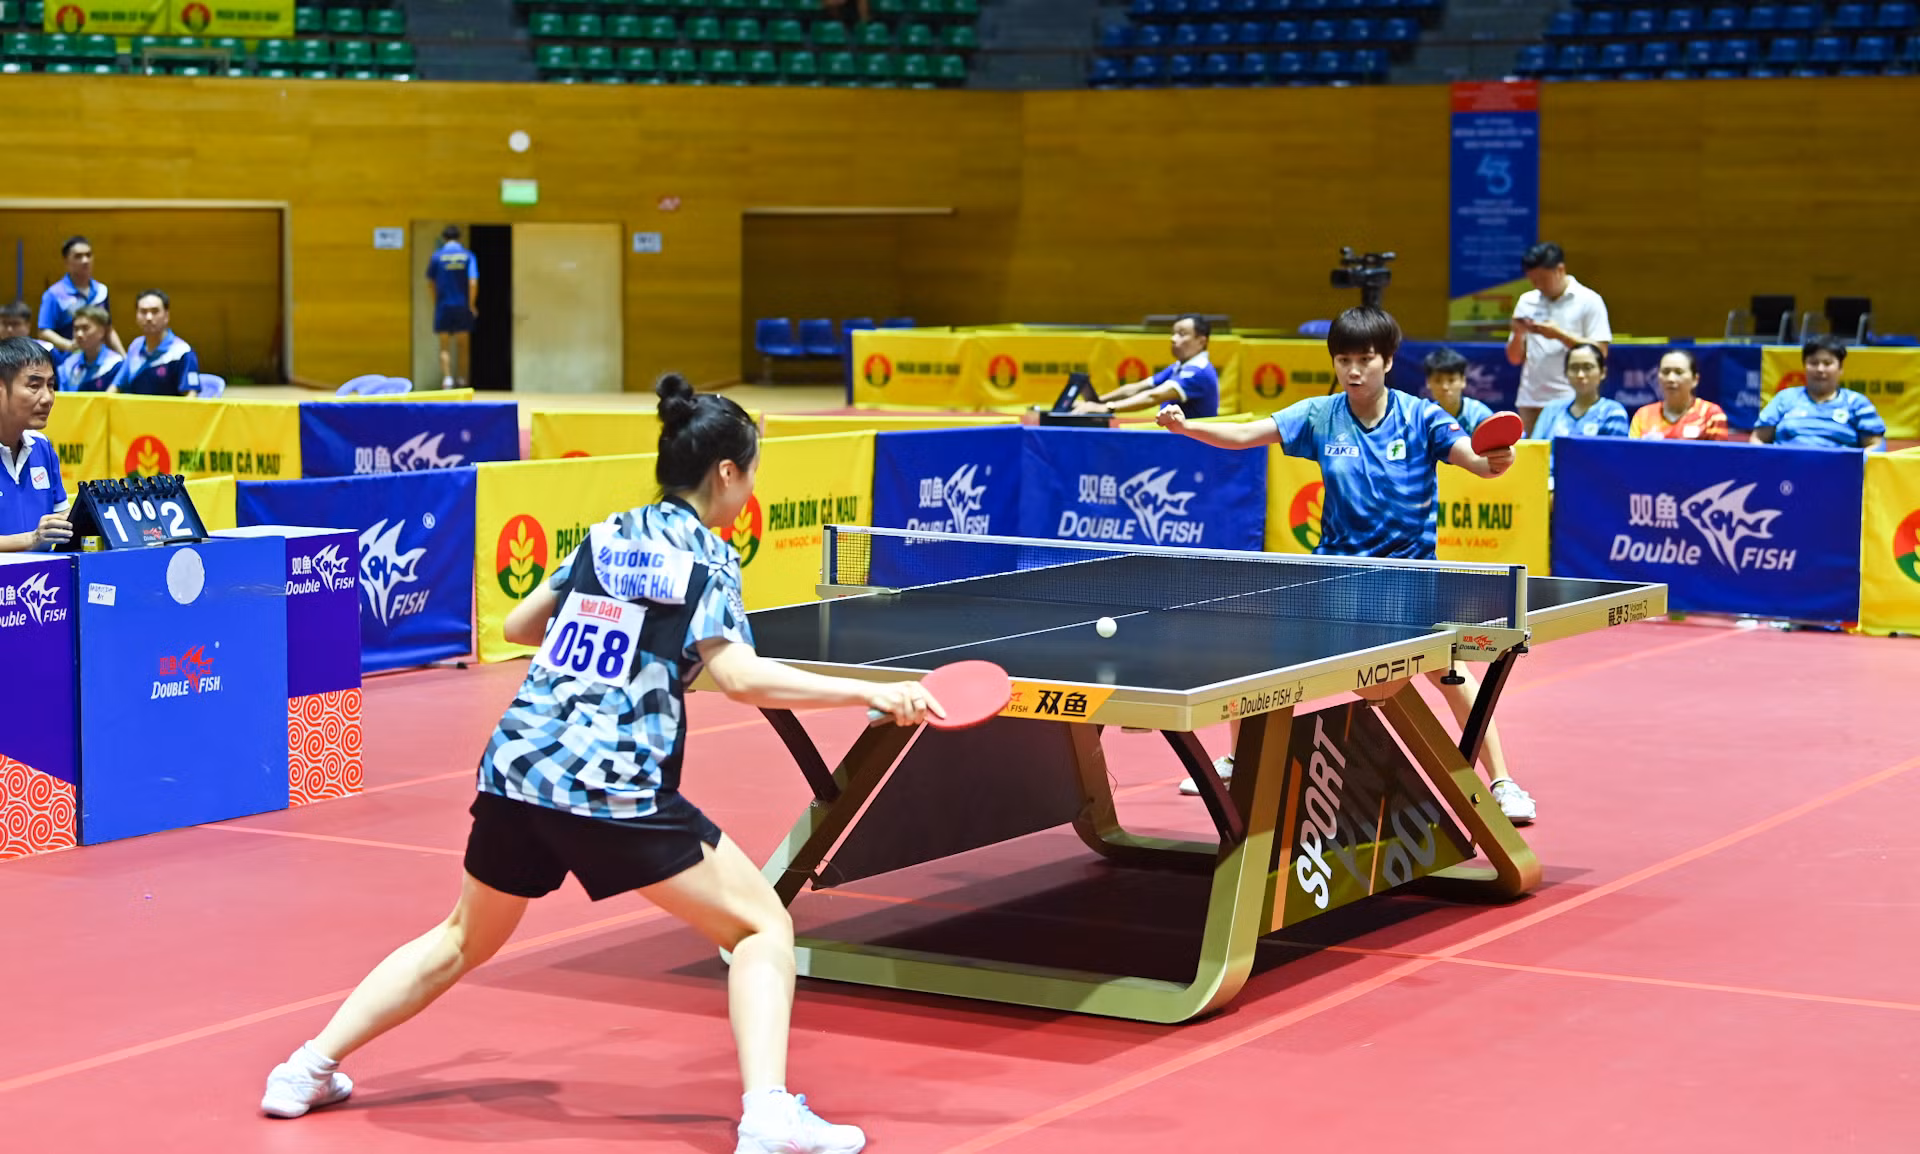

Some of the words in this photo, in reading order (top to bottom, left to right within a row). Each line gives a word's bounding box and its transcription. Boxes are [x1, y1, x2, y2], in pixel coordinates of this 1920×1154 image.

[104, 506, 128, 542] 1
[160, 502, 193, 537] 2
[769, 496, 796, 532] PHÂN
[836, 495, 857, 522] MAU
[1058, 511, 1138, 541] DOUBLE
[1159, 520, 1204, 544] FISH
[1452, 497, 1472, 529] CÀ
[1478, 502, 1512, 530] MAU
[556, 522, 590, 558] PHÂ
[1609, 534, 1702, 566] Double
[1740, 547, 1797, 571] FISH
[285, 578, 320, 596] Double
[334, 576, 355, 591] FISH
[614, 573, 647, 597] LONG
[0, 611, 27, 628] uble
[43, 608, 67, 623] FISH
[388, 589, 430, 620] FISH
[549, 620, 630, 679] 058
[150, 680, 190, 700] DOUBLE
[198, 675, 221, 694] FISH
[1356, 654, 1425, 689] MOFIT
[1010, 704, 1029, 713] FISH
[1034, 689, 1088, 718] 双鱼
[1240, 692, 1271, 716] Double
[1271, 686, 1292, 708] FISH
[1296, 713, 1347, 910] SPORT
